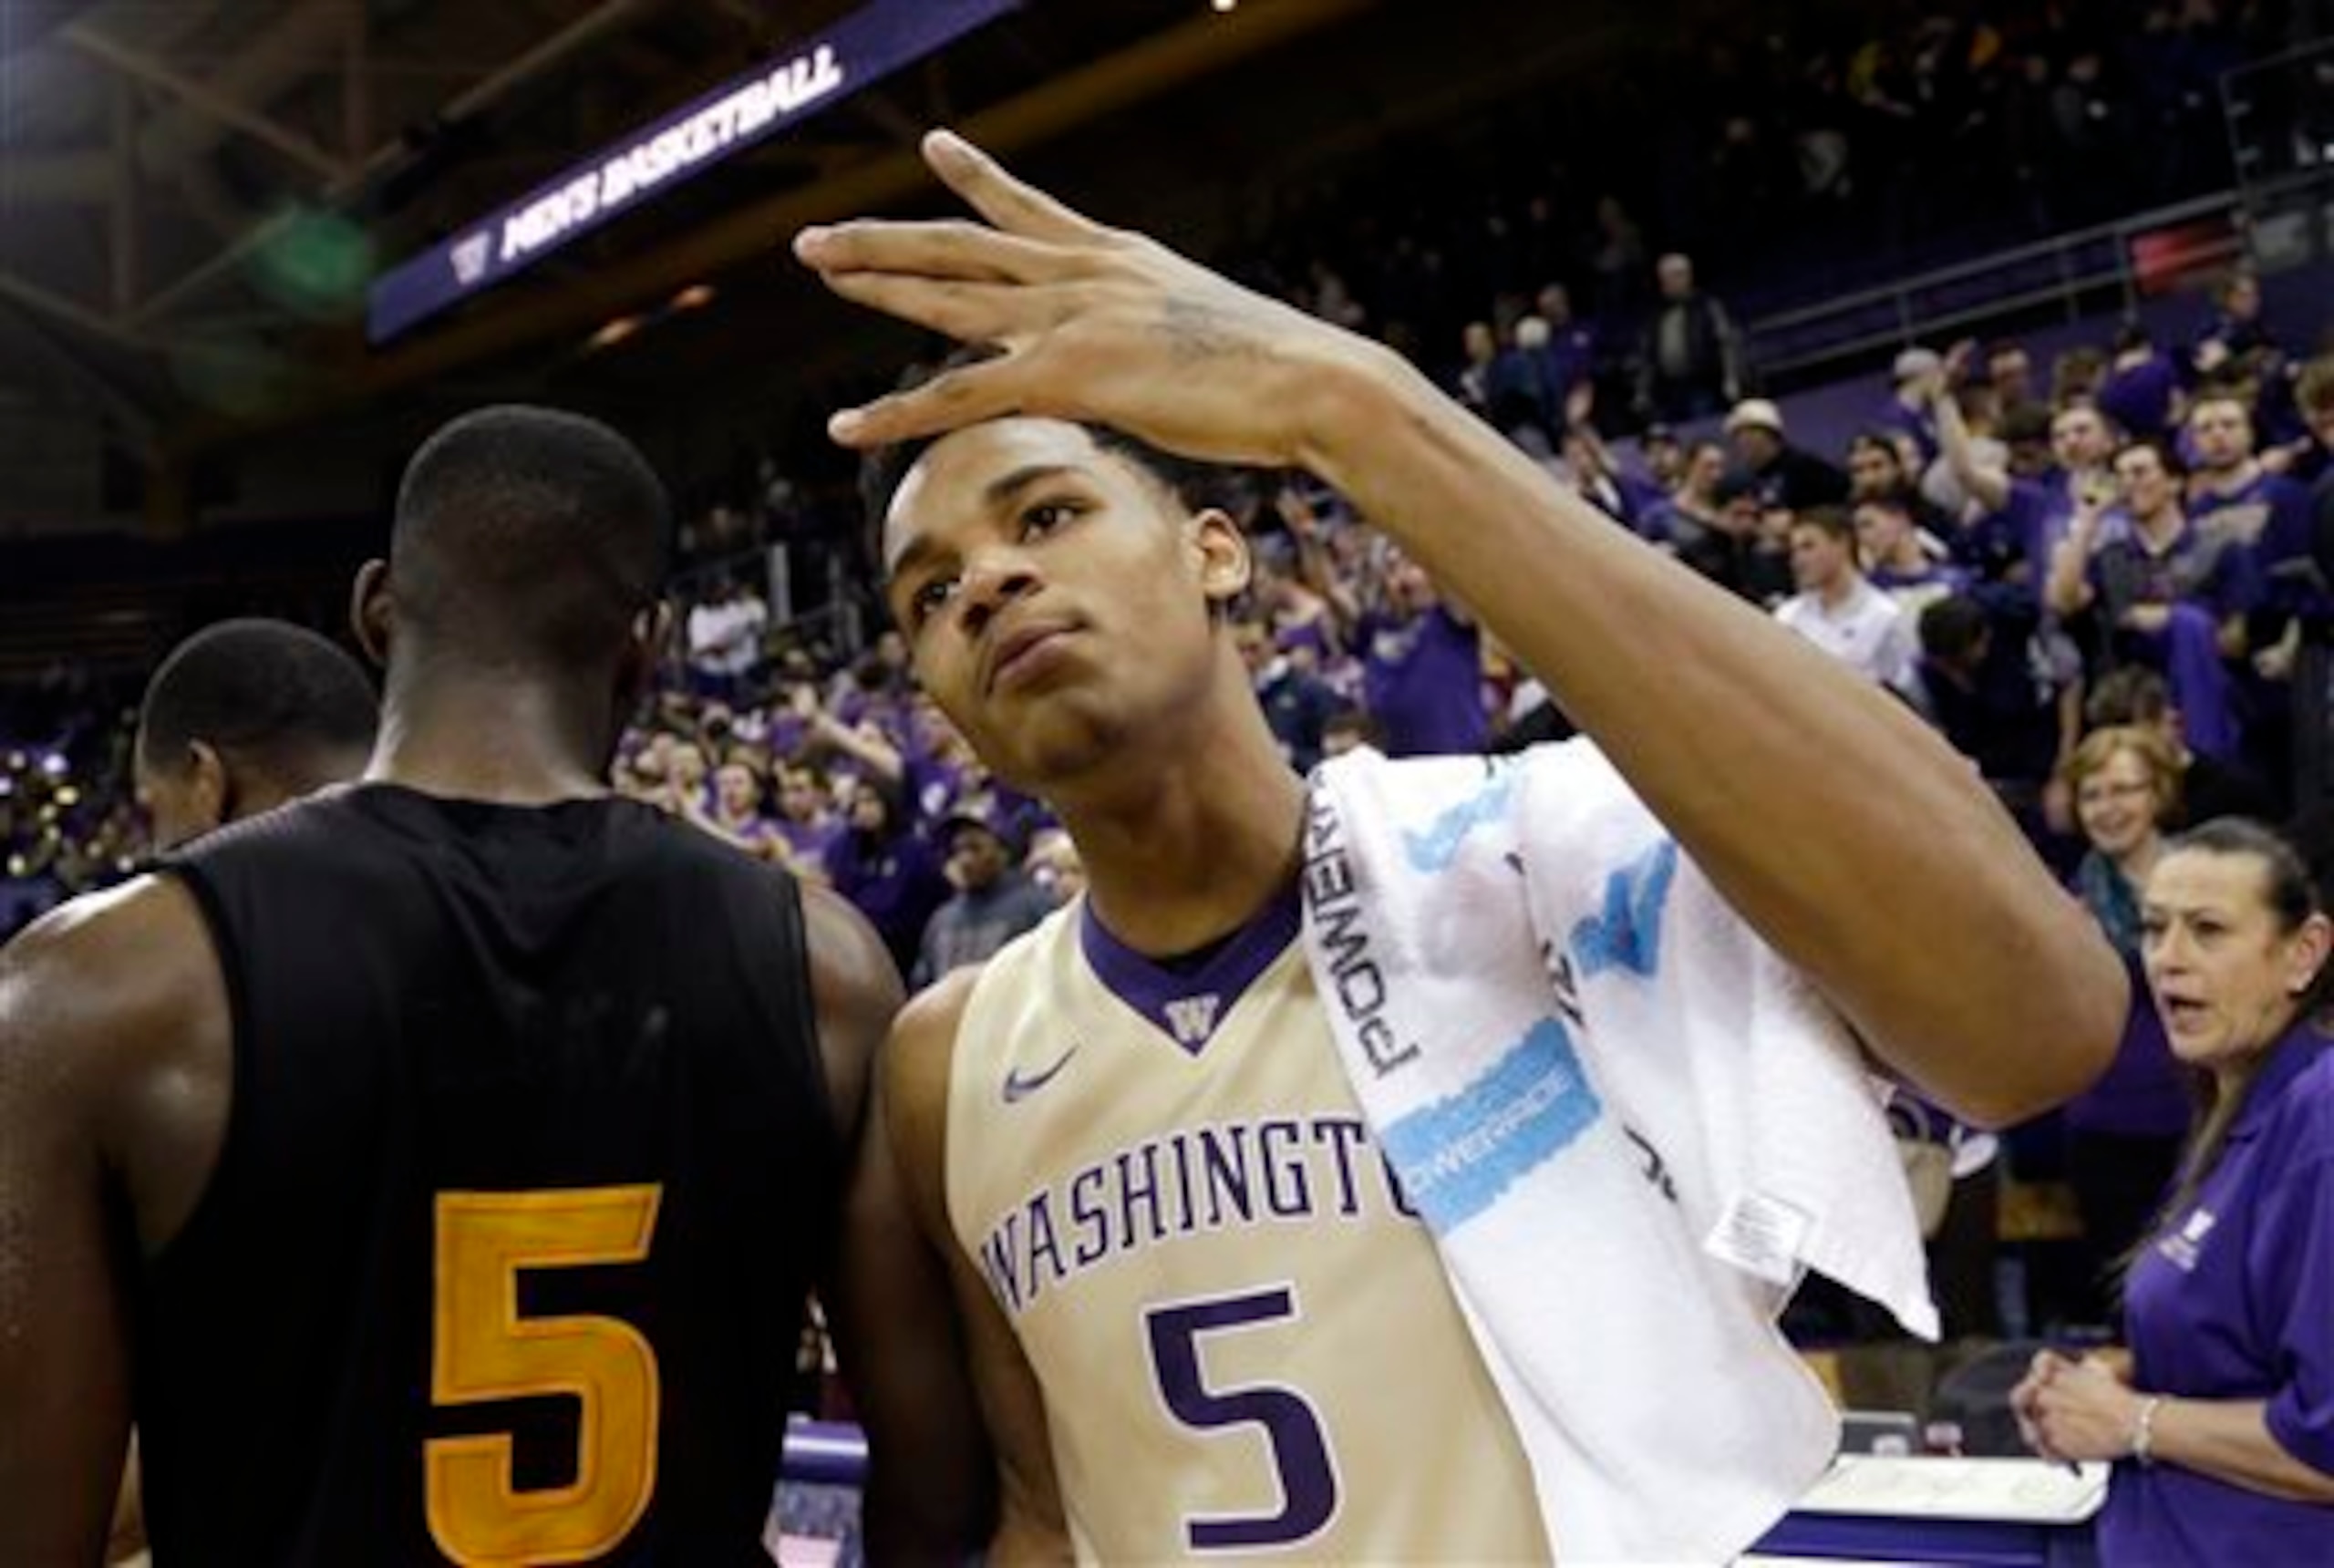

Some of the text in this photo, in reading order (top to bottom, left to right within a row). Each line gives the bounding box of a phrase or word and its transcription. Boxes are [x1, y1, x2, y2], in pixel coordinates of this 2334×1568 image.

[501, 170, 600, 262] MEN'S
[598, 45, 842, 208] BASKETBALL
[1310, 806, 1422, 1079] POWER
[424, 1182, 663, 1568] 5
[1144, 1284, 1338, 1553] 5
